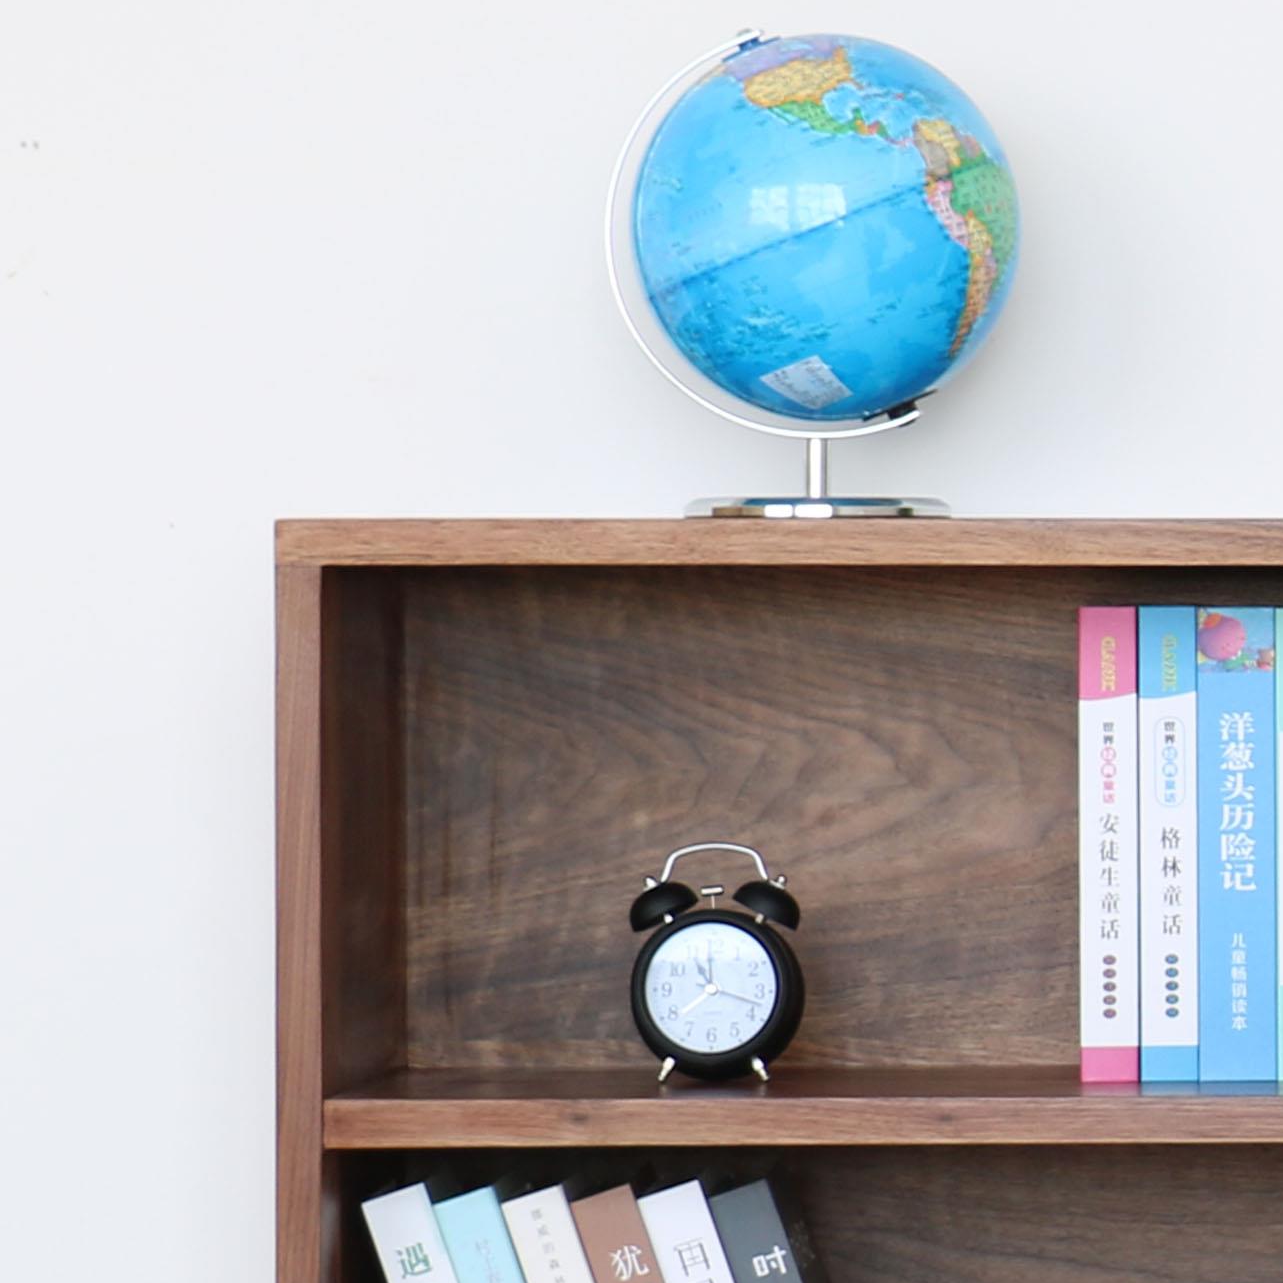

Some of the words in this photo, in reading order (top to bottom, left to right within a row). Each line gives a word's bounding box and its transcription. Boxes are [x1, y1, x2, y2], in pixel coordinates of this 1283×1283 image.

[1219, 712, 1256, 892] 洋葱头历险记
[1099, 813, 1121, 940] 安徒生童话
[1160, 827, 1183, 936] 格林童话
[669, 961, 686, 977] 10
[748, 962, 759, 977] 2
[661, 981, 673, 998] 9
[1230, 932, 1248, 1031] 儿童畅销读本
[754, 983, 765, 999] 3
[667, 1005, 678, 1021] 8
[745, 1005, 756, 1022] 4
[684, 1021, 695, 1037] 7
[706, 1027, 717, 1043] 6
[729, 1021, 740, 1038] 5
